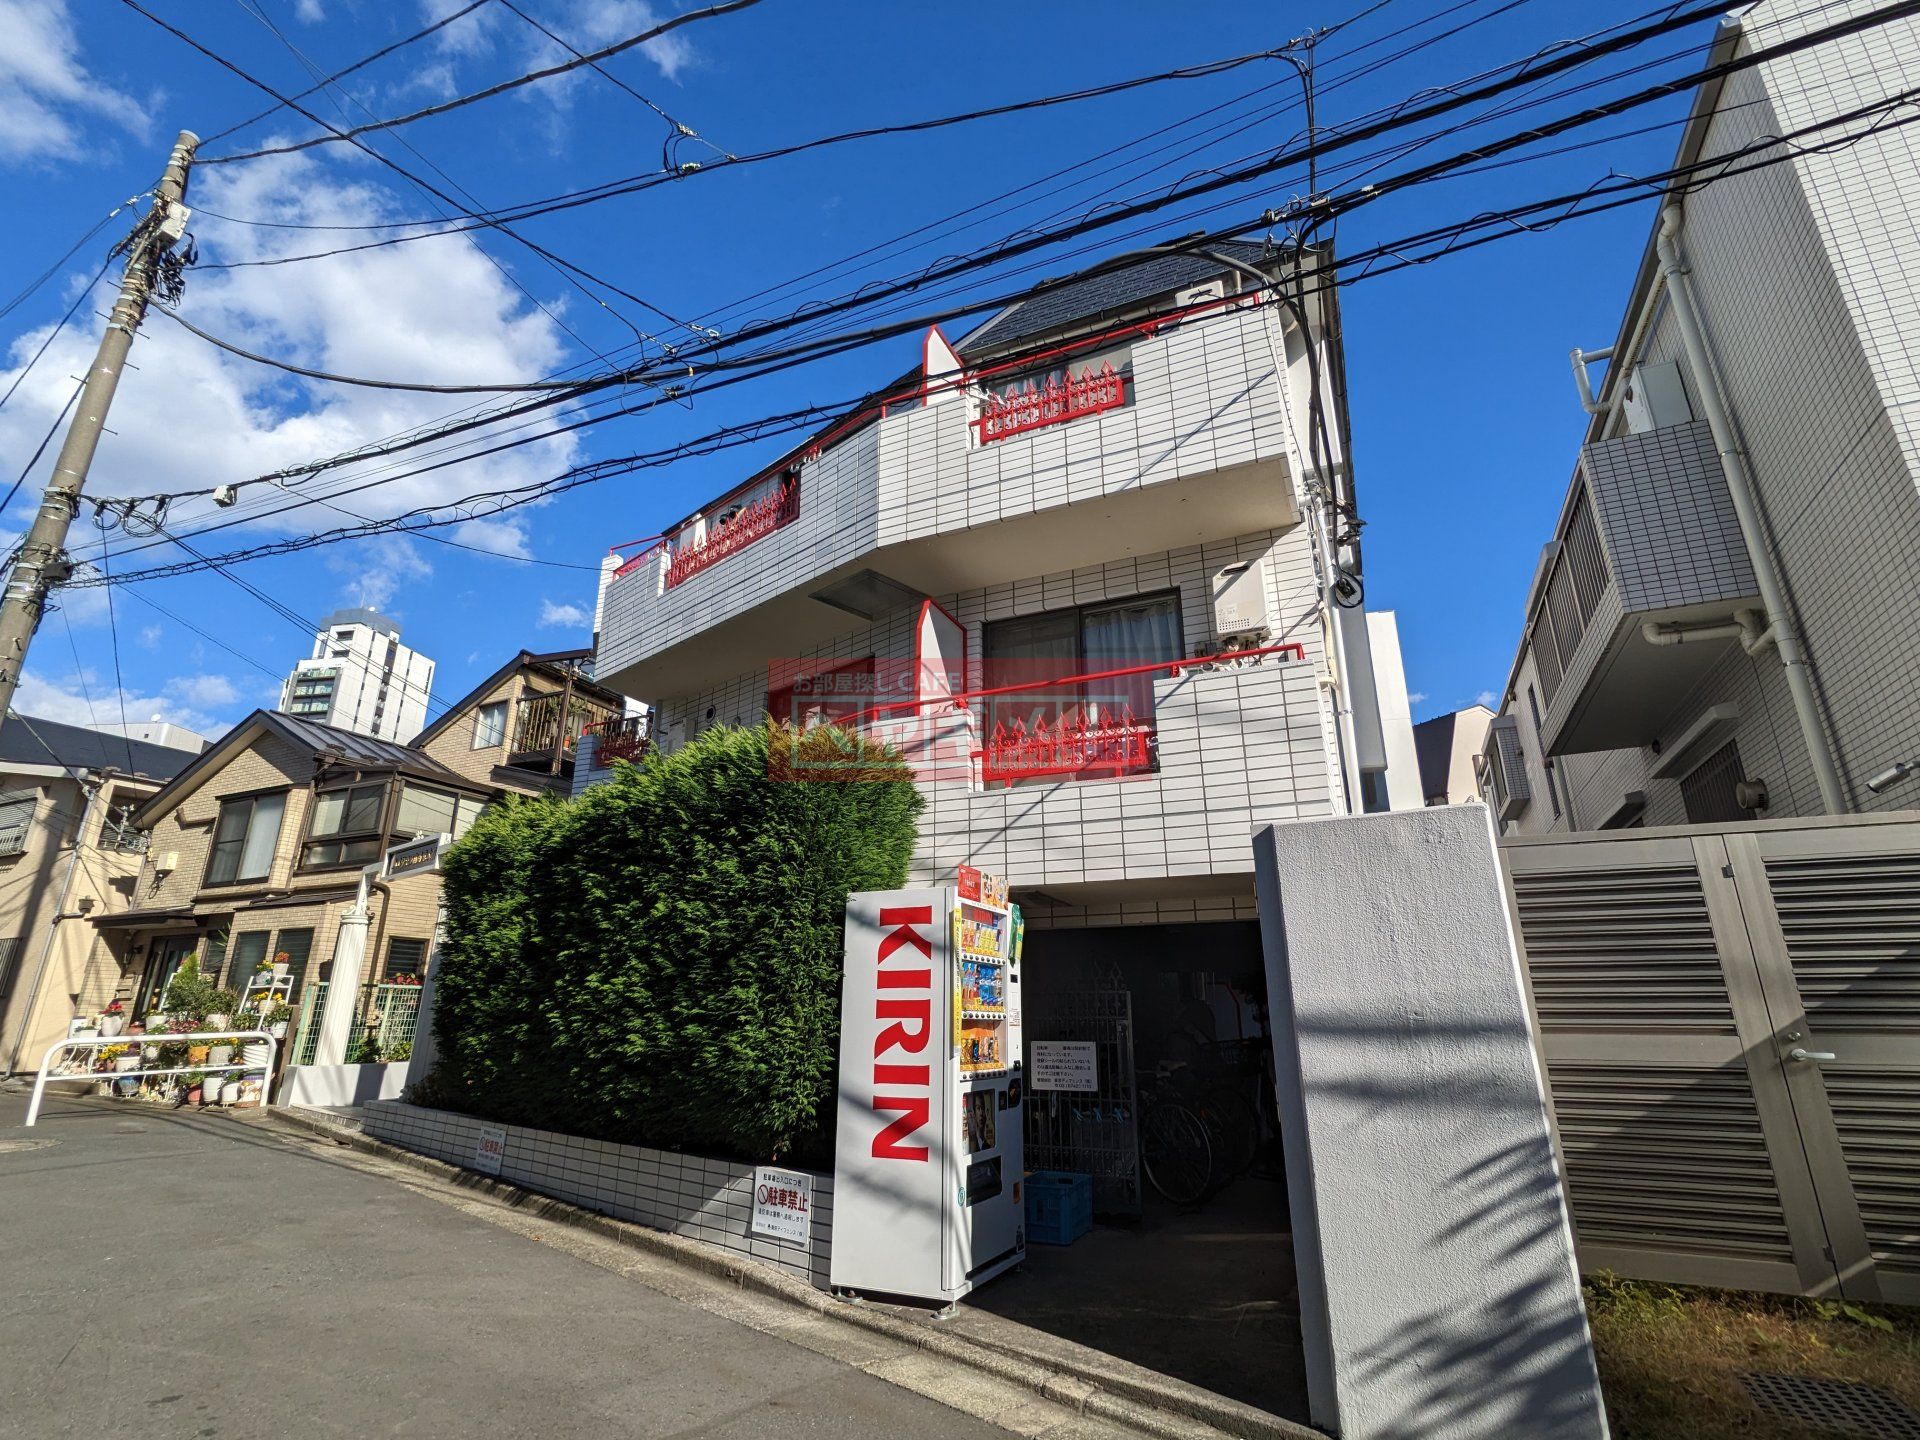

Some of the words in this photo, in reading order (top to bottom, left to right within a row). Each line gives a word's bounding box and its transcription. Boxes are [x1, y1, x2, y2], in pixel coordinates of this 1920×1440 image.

[872, 905, 933, 1162] KIRIN
[767, 1186, 808, 1212] 駐車禁止
